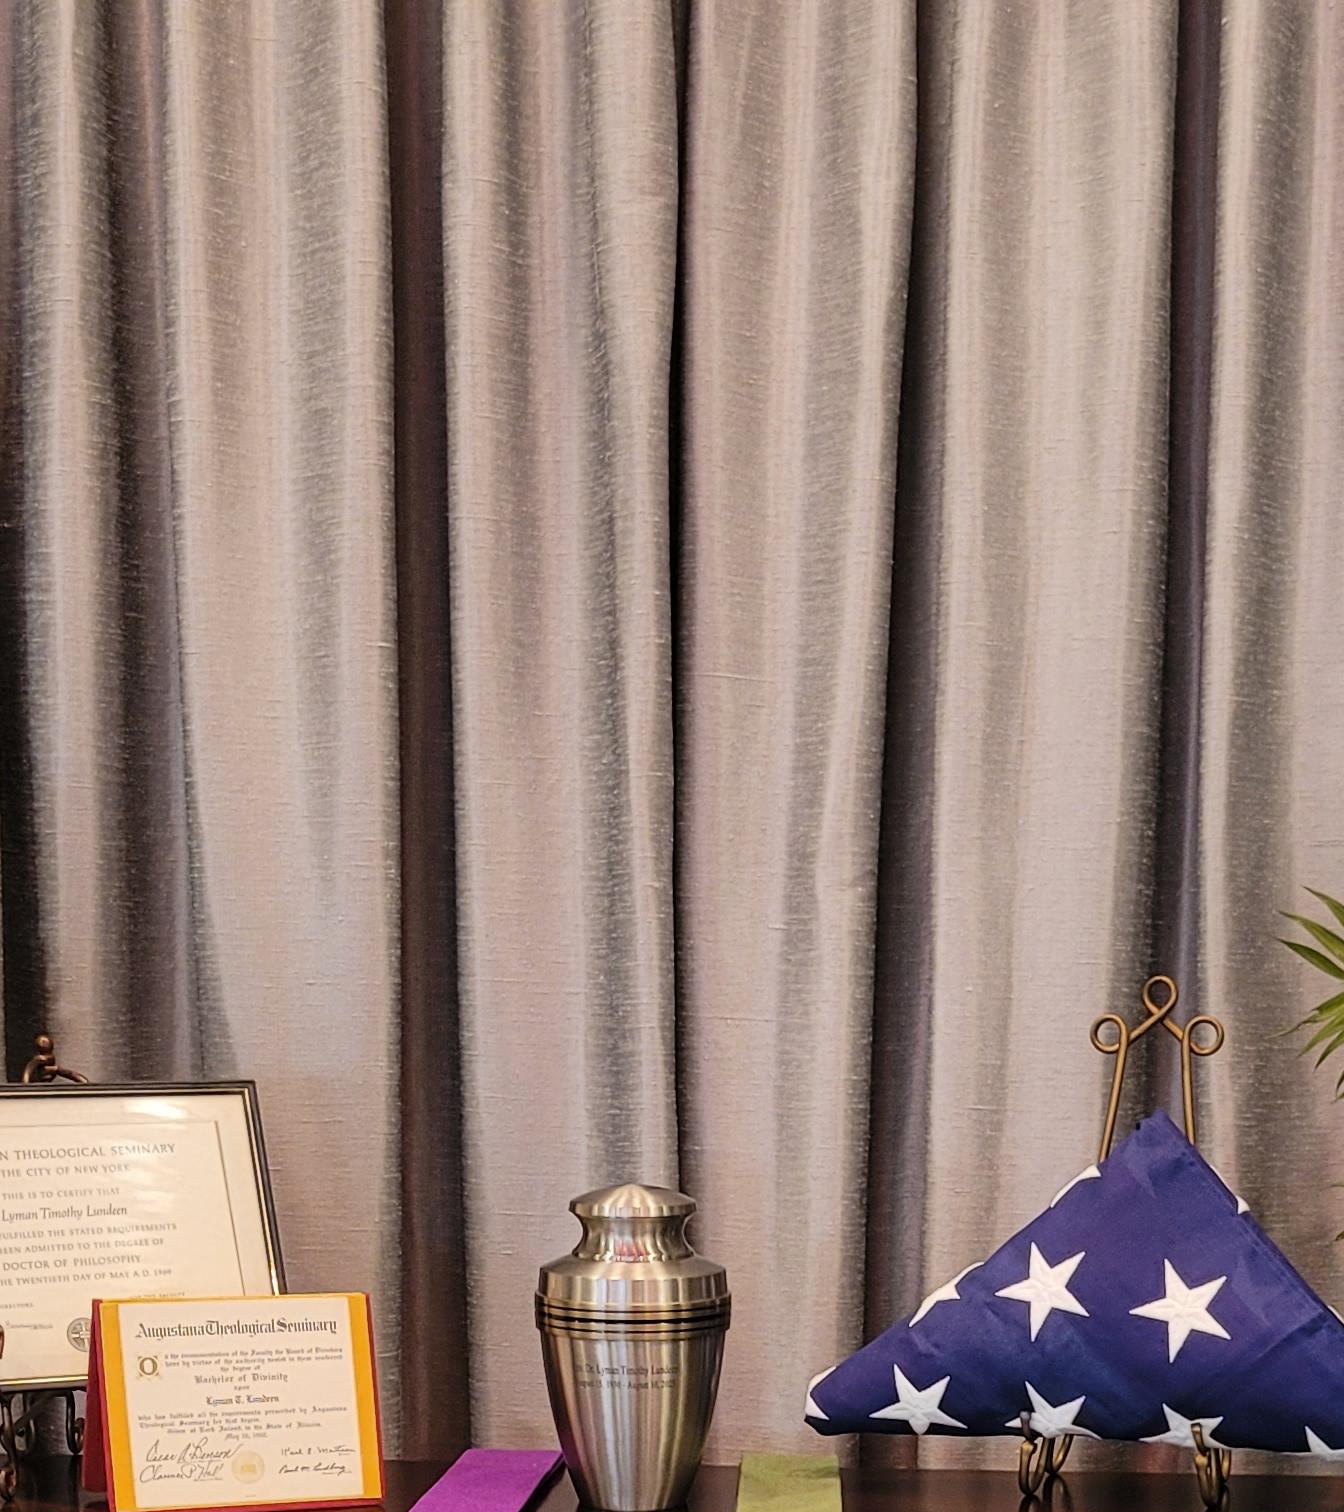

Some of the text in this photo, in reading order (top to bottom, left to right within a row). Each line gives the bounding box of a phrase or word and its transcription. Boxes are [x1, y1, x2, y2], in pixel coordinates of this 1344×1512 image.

[13, 1147, 105, 1159] THEOLOGICAL
[110, 1144, 174, 1155] SEMINARY
[0, 1169, 21, 1177] THE
[26, 1168, 50, 1176] CITY
[56, 1166, 69, 1175] OF
[101, 1163, 130, 1173] YORK
[1, 1203, 127, 1223] Lyman Timothy Lundeen
[69, 1227, 103, 1235] STATED
[24, 1243, 73, 1252] ADMITTED
[2, 1255, 140, 1270] DOCTOR OF PHILOSOPHY
[16, 1275, 69, 1284] TWENTIETH
[135, 1317, 337, 1341] Augustana Theological Seminary
[252, 1373, 287, 1381] Divinity
